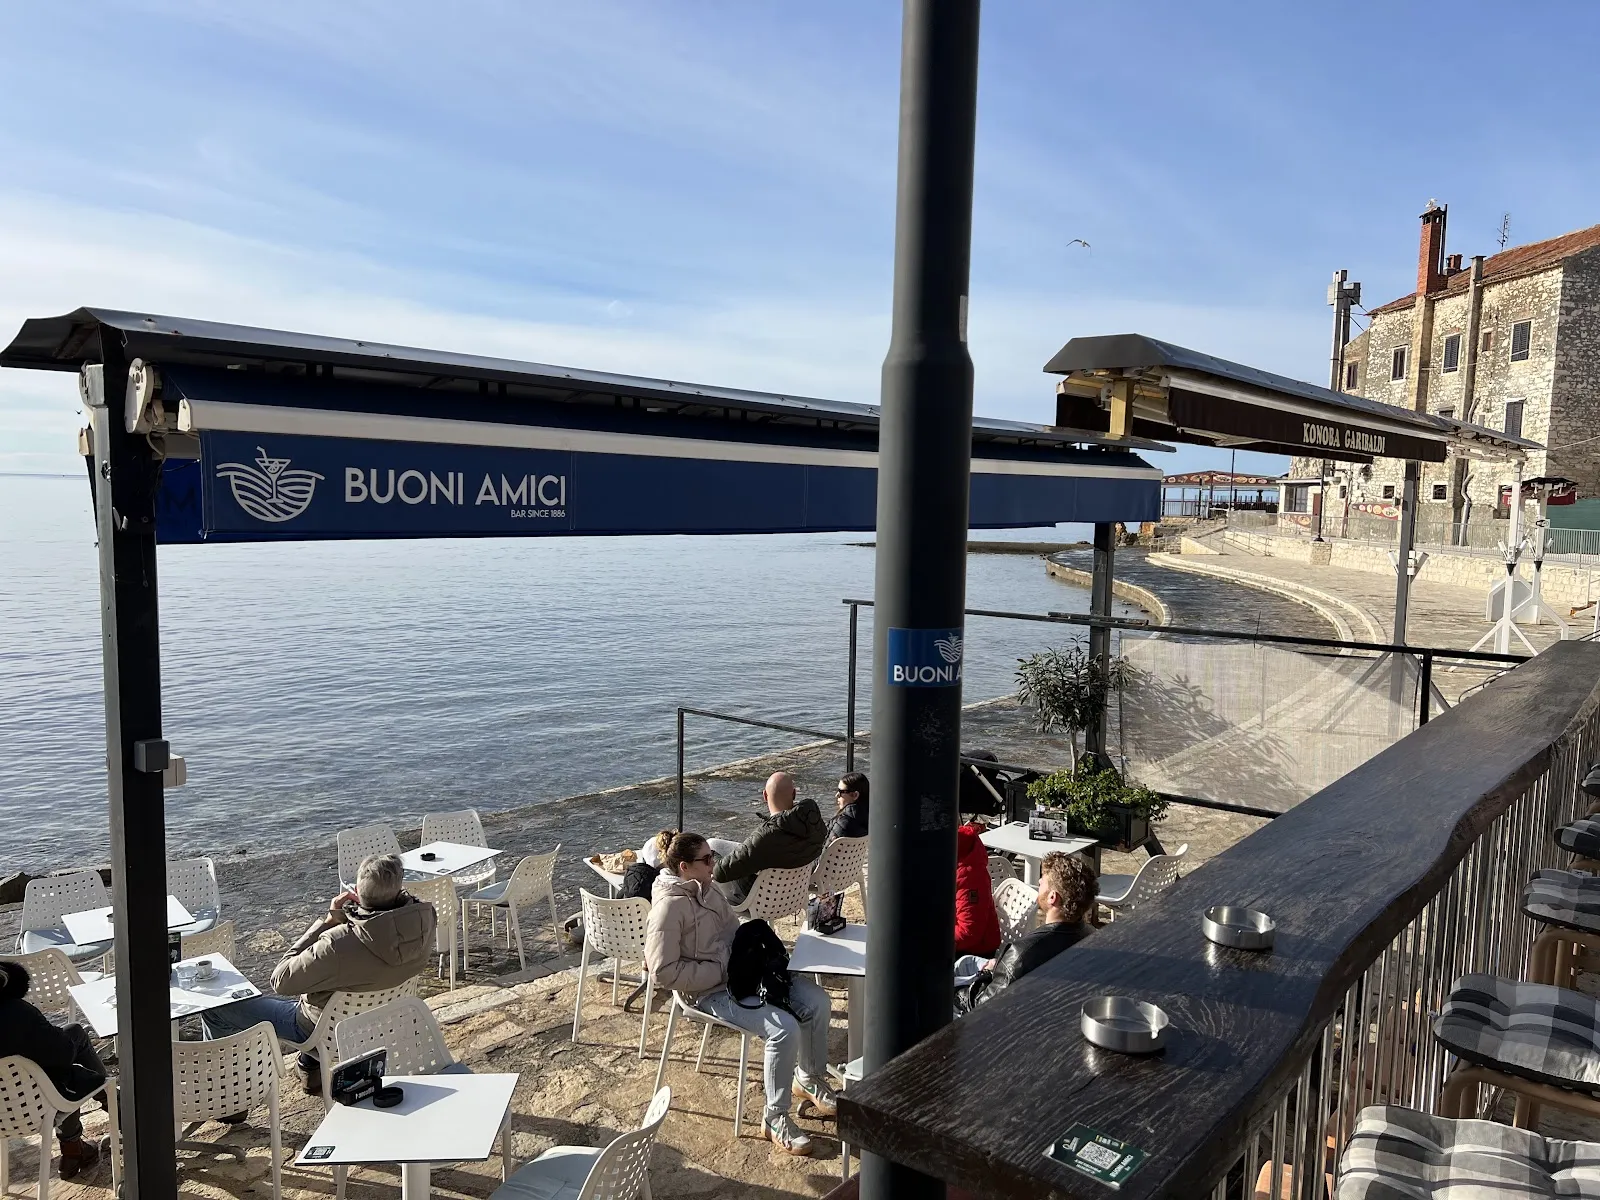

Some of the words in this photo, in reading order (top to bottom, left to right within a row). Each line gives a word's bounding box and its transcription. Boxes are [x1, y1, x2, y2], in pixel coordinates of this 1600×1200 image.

[1303, 422, 1340, 447] KONOBA
[1344, 430, 1386, 453] GARIBALDI
[345, 467, 464, 505] BUONI
[475, 473, 566, 506] AMICI
[510, 509, 527, 518] BAR
[527, 509, 550, 518] SINCE
[550, 509, 566, 518] 1886
[893, 664, 953, 682] BUONI
